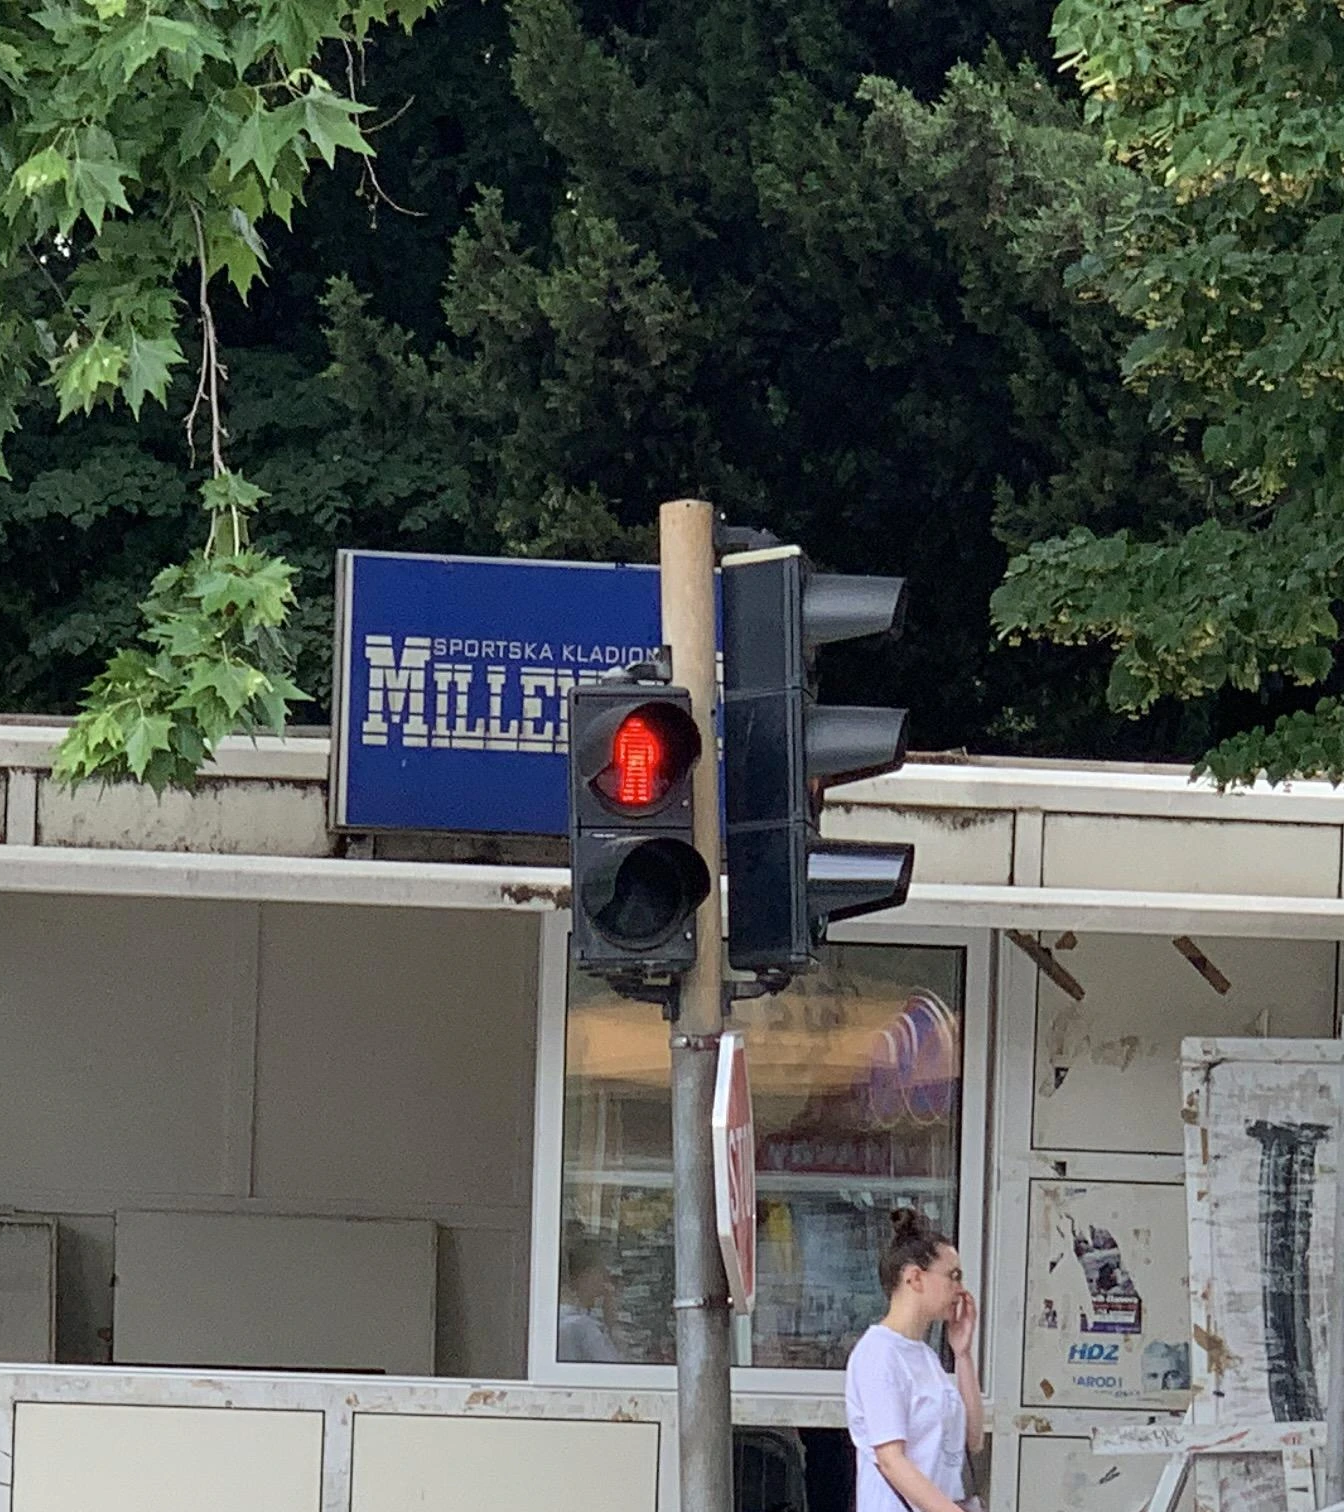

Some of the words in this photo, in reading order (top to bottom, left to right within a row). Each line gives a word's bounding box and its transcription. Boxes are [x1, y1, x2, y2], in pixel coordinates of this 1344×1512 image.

[432, 637, 555, 661] SPORTSKA
[561, 643, 659, 665] KLADION
[361, 634, 664, 755] MILLE
[1067, 1342, 1120, 1361] HDZ
